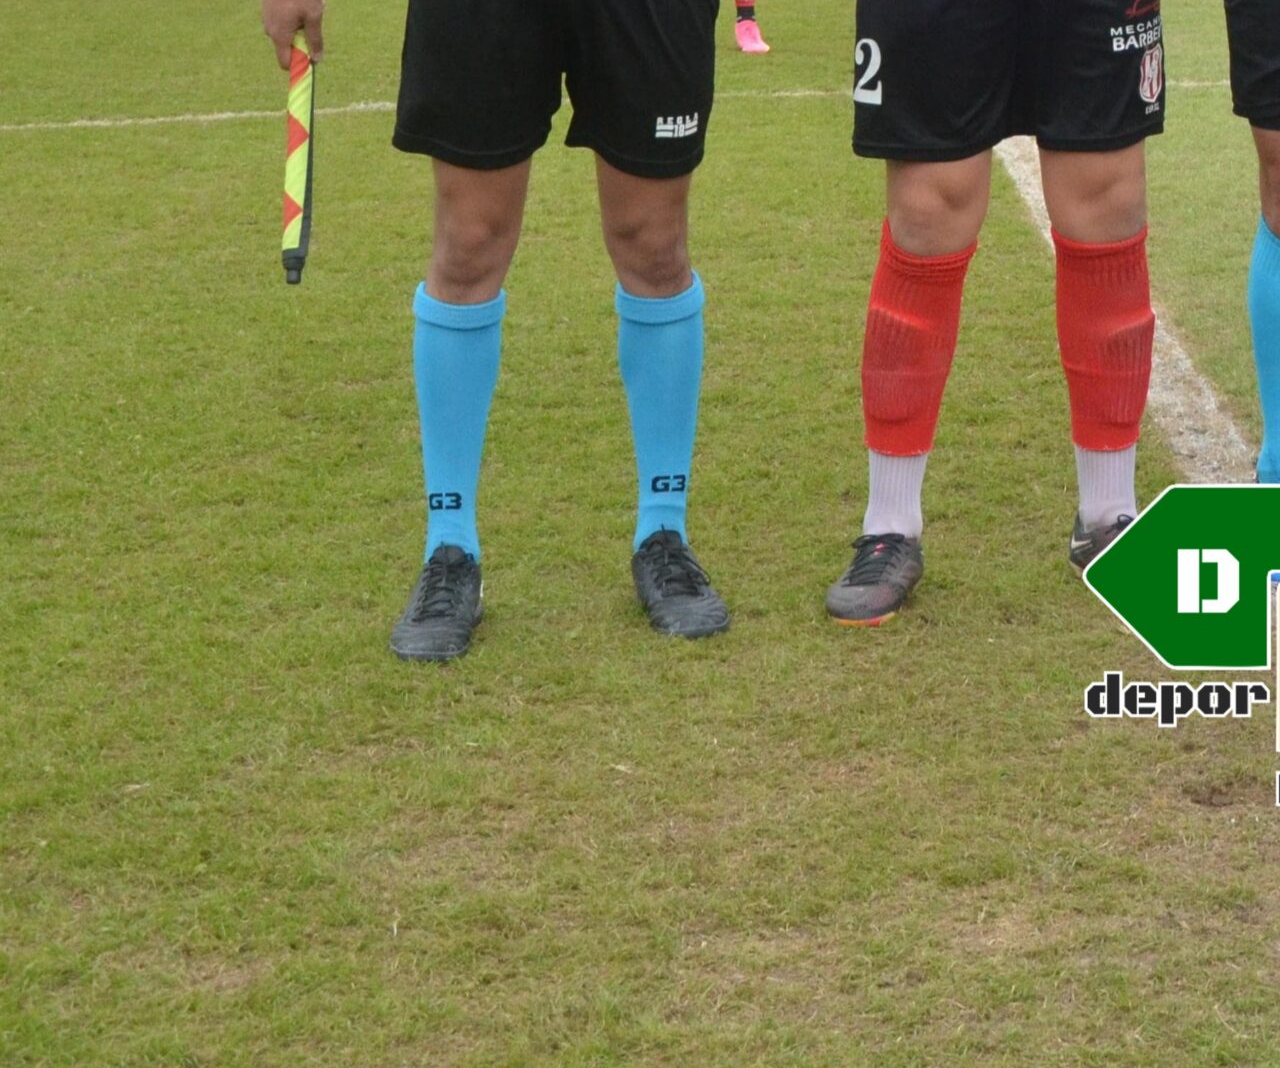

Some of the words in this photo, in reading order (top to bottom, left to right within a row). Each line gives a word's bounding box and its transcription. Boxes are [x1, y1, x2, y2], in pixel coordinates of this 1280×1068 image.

[853, 38, 882, 105] 2
[651, 475, 686, 492] G3
[429, 493, 462, 510] G3
